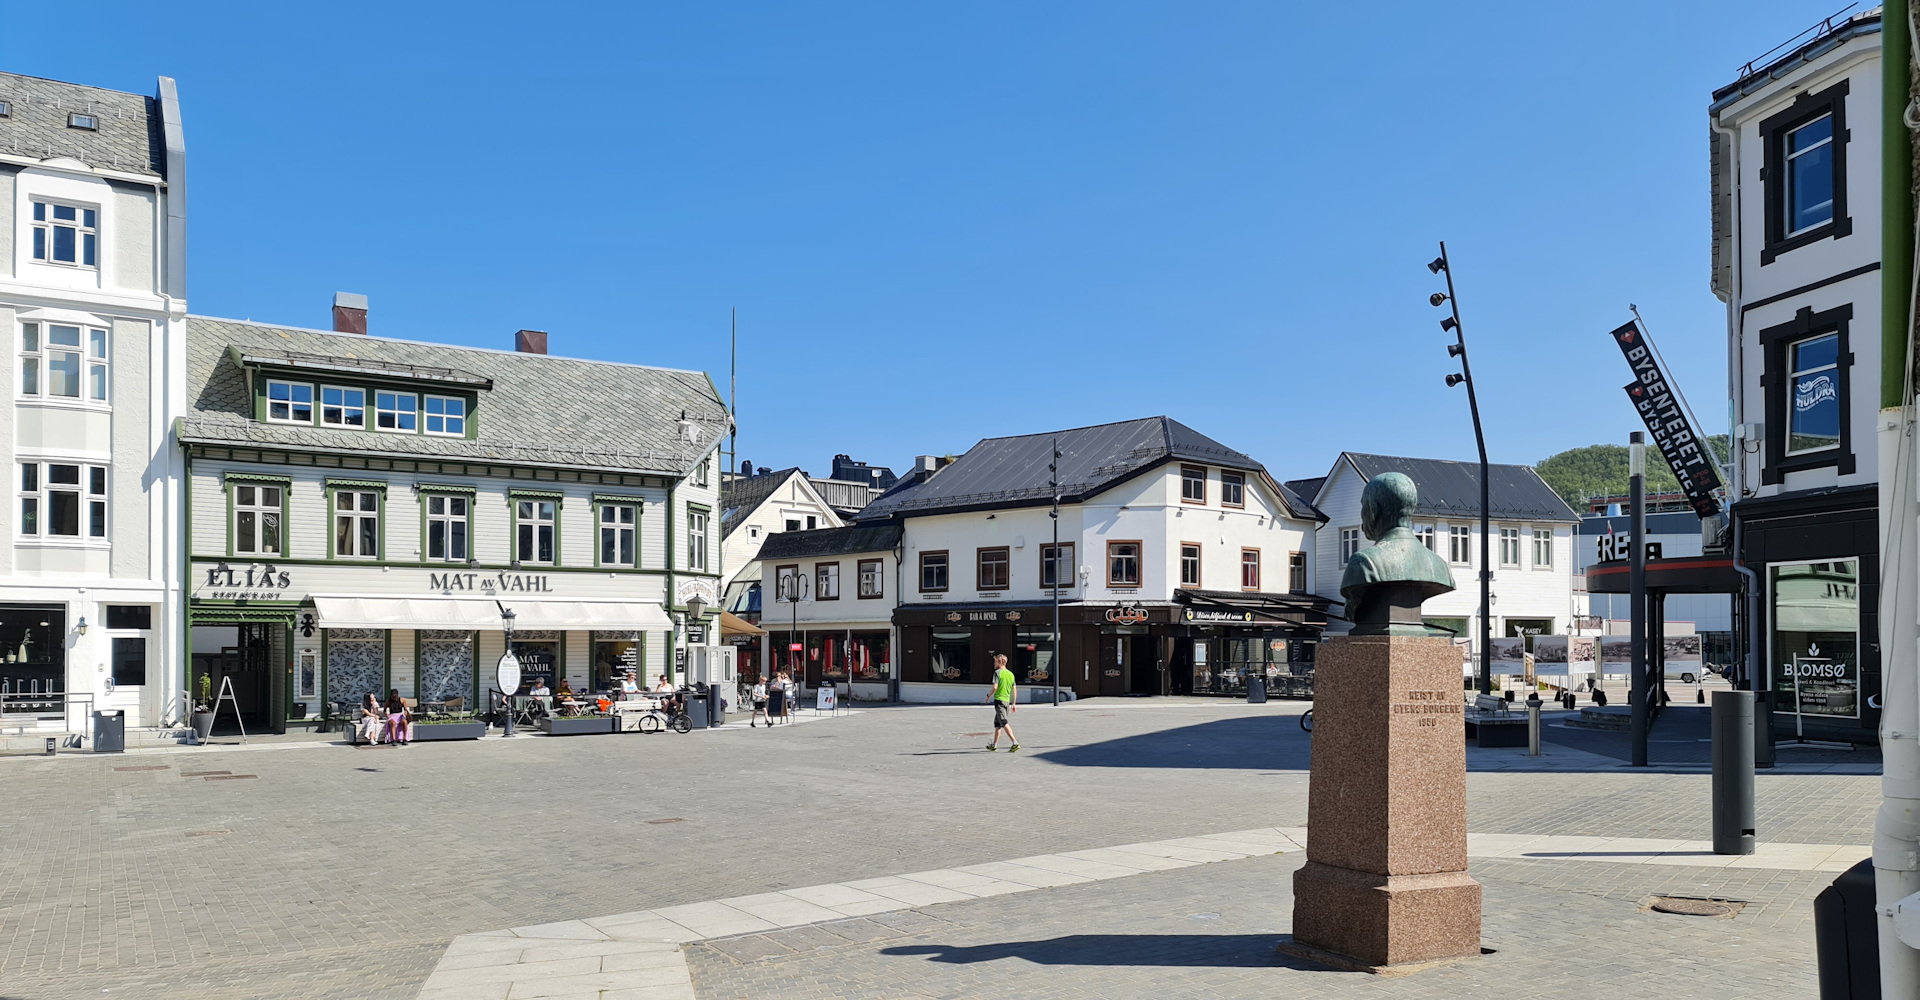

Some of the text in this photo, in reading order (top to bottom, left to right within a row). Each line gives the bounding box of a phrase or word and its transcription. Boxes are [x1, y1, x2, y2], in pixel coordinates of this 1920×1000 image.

[1628, 345, 1705, 467] BYSENTERET
[430, 573, 478, 590] MAT
[498, 574, 553, 592] VAHL
